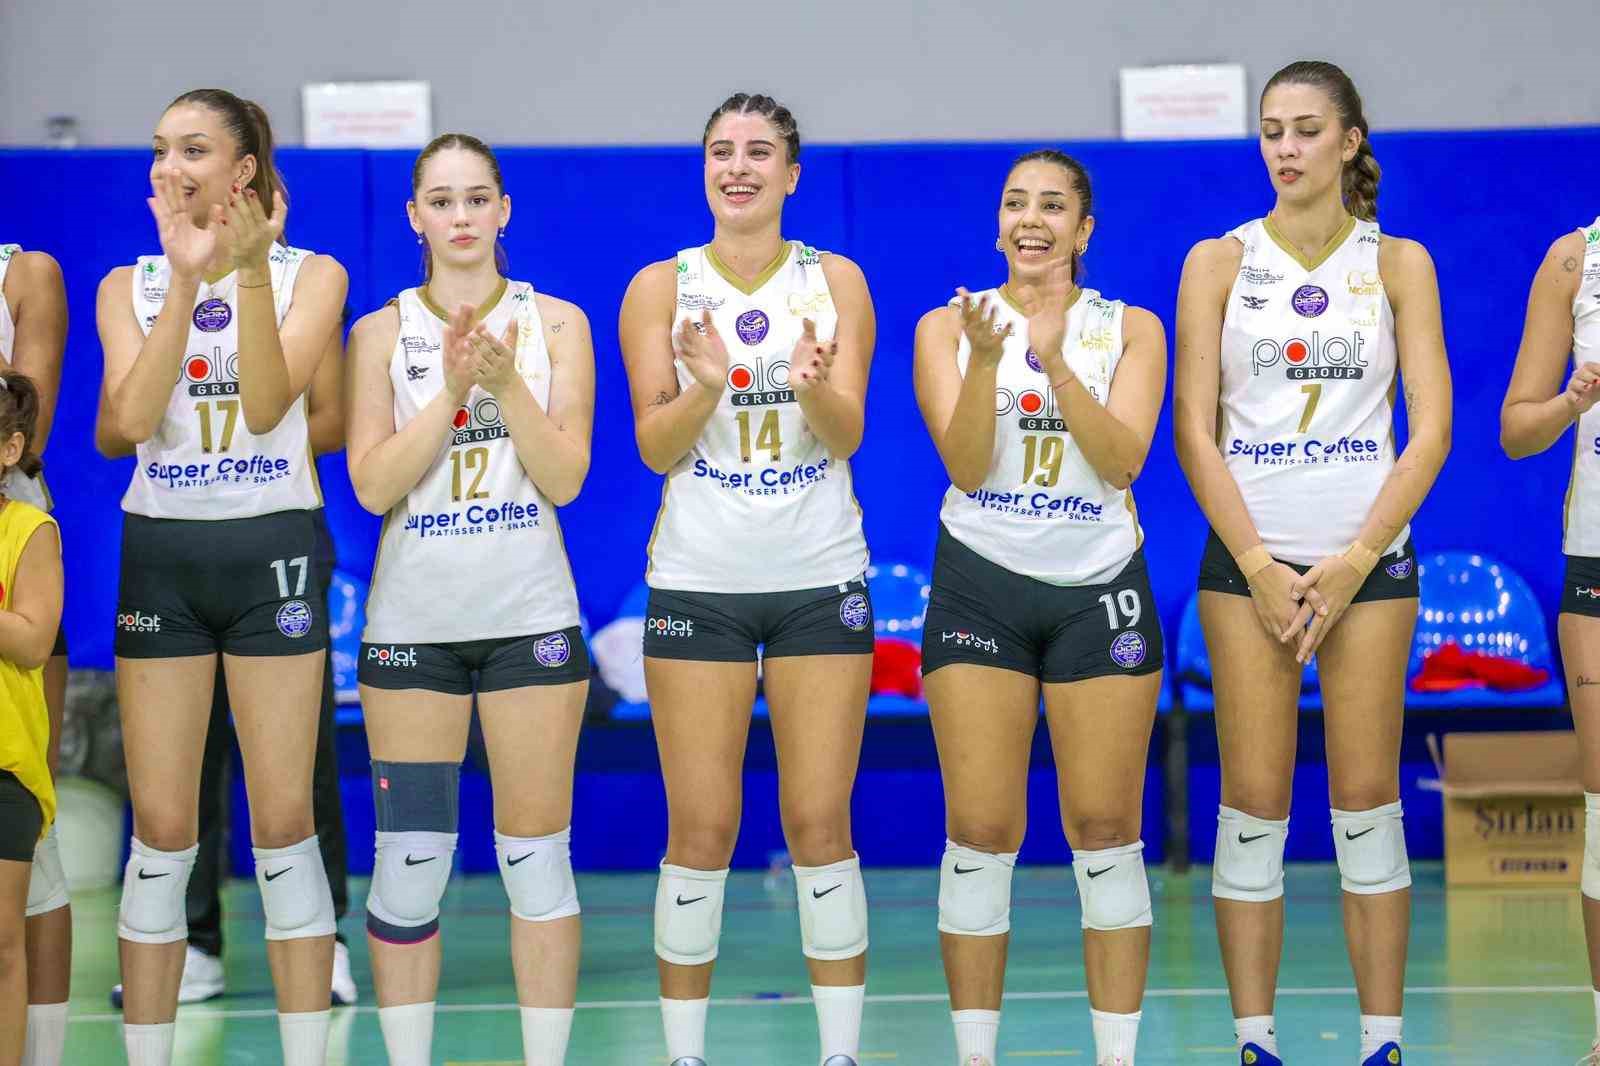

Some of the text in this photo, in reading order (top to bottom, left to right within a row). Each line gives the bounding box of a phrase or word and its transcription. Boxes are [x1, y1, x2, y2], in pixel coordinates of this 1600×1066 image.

[1252, 331, 1368, 376] polat
[197, 384, 236, 394] GRO
[1295, 368, 1356, 378] GROUP
[739, 393, 796, 405] GROU
[1298, 383, 1321, 433] 7
[195, 400, 239, 454] 17
[736, 409, 783, 463] 14
[1027, 420, 1064, 430] GRO
[1022, 435, 1065, 488] 19
[1229, 436, 1378, 464] Super Coffee
[147, 455, 289, 488] Super Coffee
[450, 447, 489, 502] 12
[404, 502, 538, 537] uper Coffee
[508, 520, 539, 531] SNACK
[270, 556, 308, 598] 17
[118, 611, 160, 627] polat
[648, 616, 693, 631] polat
[1099, 589, 1141, 629] 19
[368, 646, 416, 661] polat
